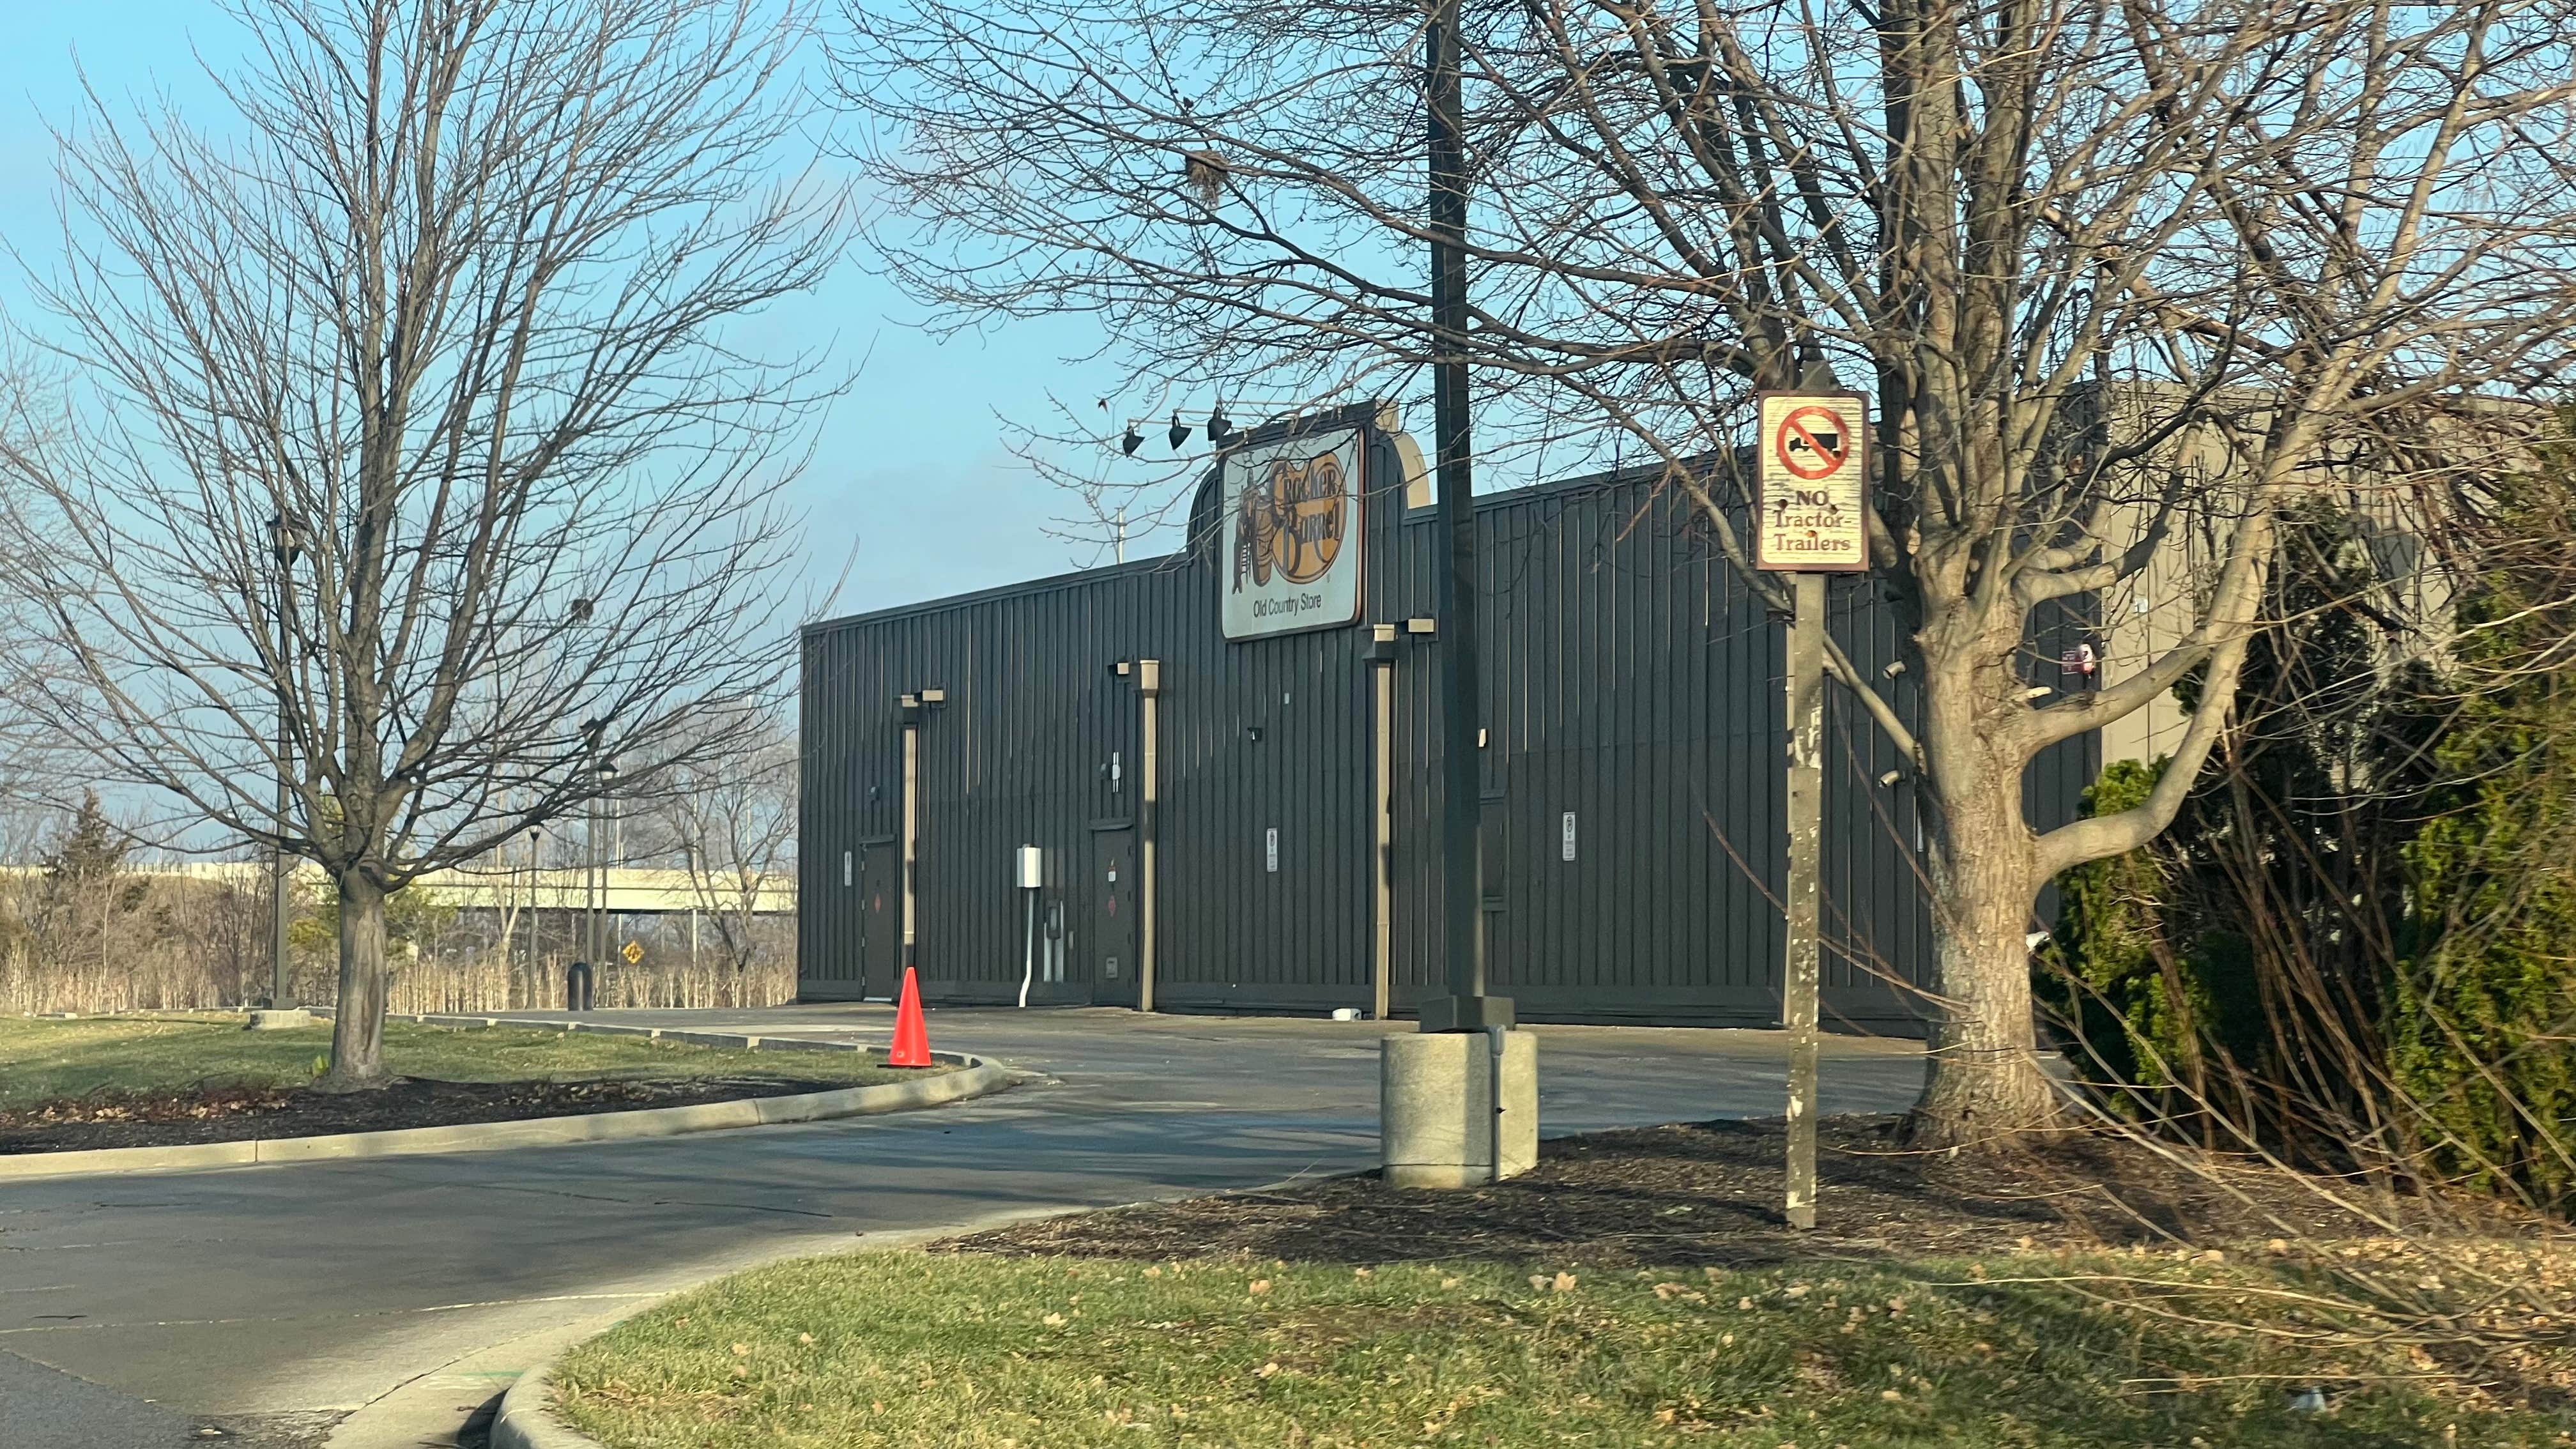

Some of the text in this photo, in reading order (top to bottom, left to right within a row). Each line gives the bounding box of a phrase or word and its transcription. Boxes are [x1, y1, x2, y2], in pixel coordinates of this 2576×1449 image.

[1796, 490, 1828, 505] NO
[1774, 533, 1851, 551] Trailers
[1254, 592, 1322, 618] Old Country Store
